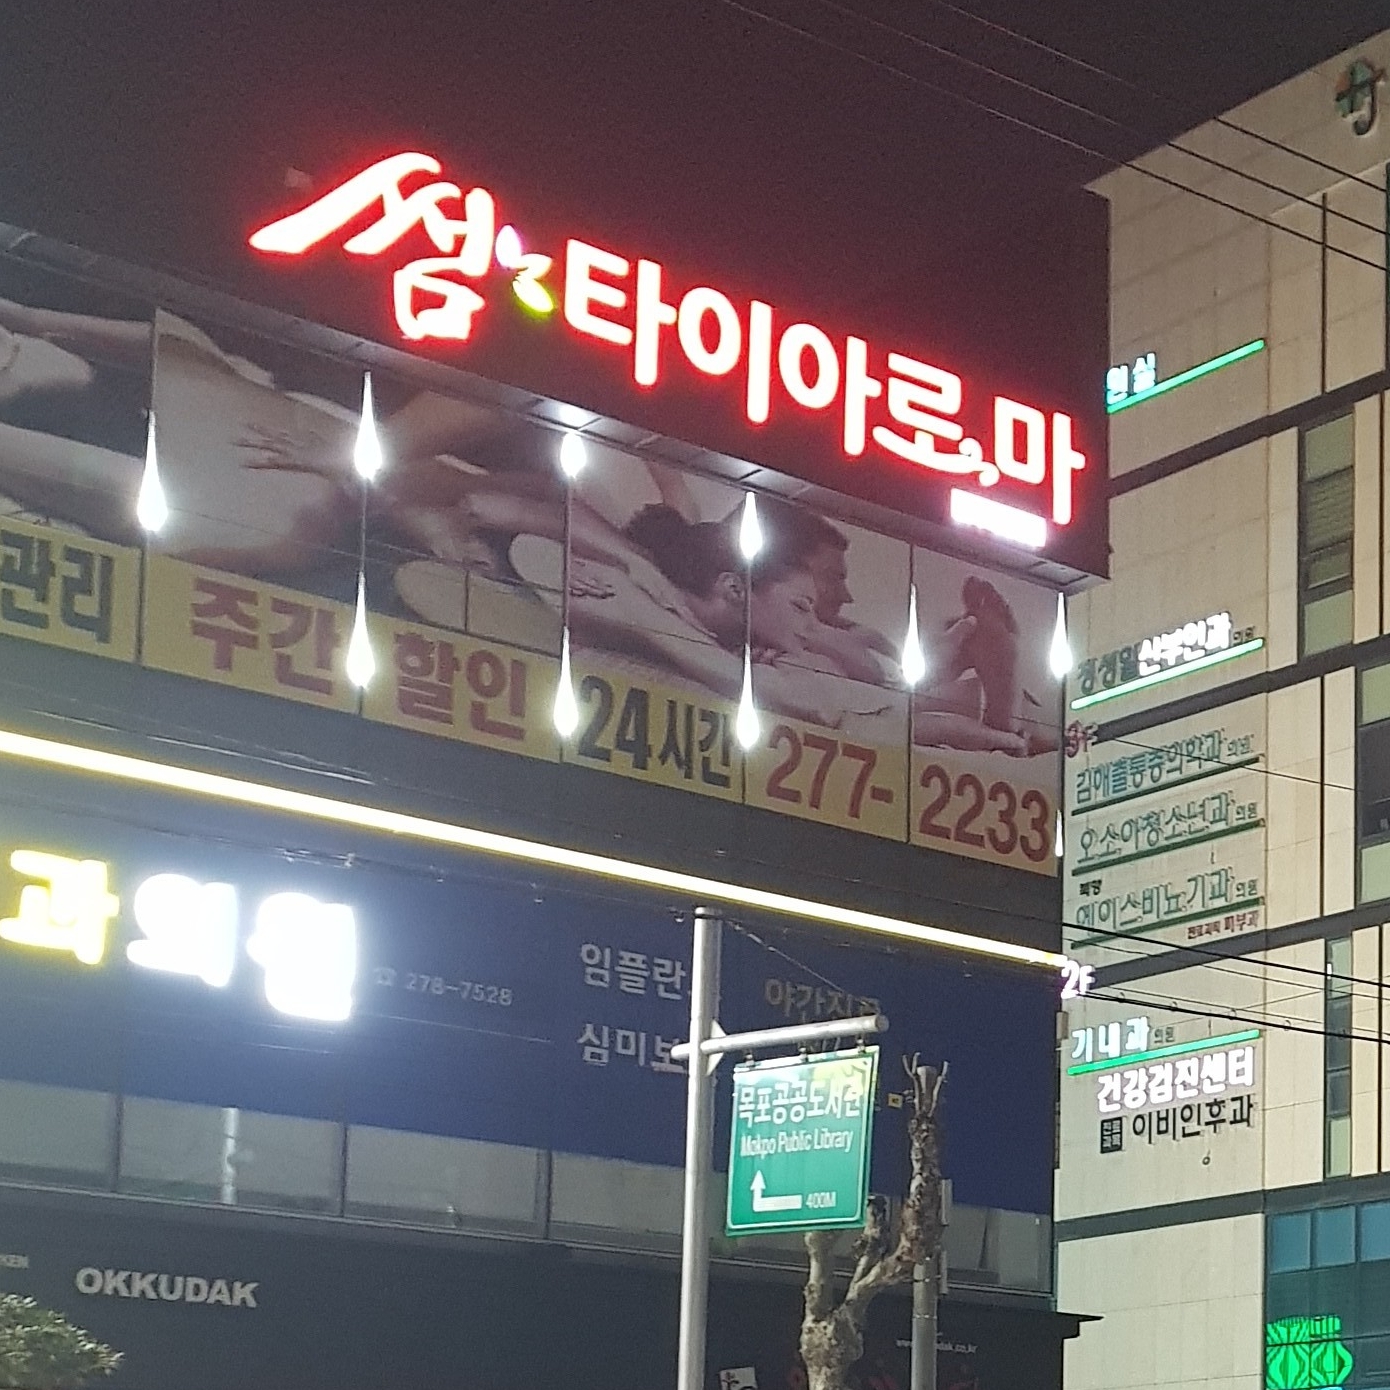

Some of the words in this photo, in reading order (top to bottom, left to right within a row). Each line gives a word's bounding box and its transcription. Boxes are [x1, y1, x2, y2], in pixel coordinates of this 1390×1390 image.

[0, 529, 114, 644] 관리
[189, 575, 342, 697] 주간
[396, 631, 527, 742] 할인
[577, 674, 732, 788] 24시간
[1076, 866, 1234, 936] 에이스비뇨기과
[580, 942, 692, 1000] 임플란
[577, 1022, 688, 1075] 심미보
[1097, 1046, 1255, 1114] 건강검진센터
[740, 1134, 777, 1160] Mokpo
[778, 1130, 813, 1154] Public
[814, 1127, 854, 1153] Library
[1133, 1094, 1255, 1144] 이비인후과
[806, 1191, 837, 1209] 400M
[75, 1266, 259, 1308] OKKUDAK
